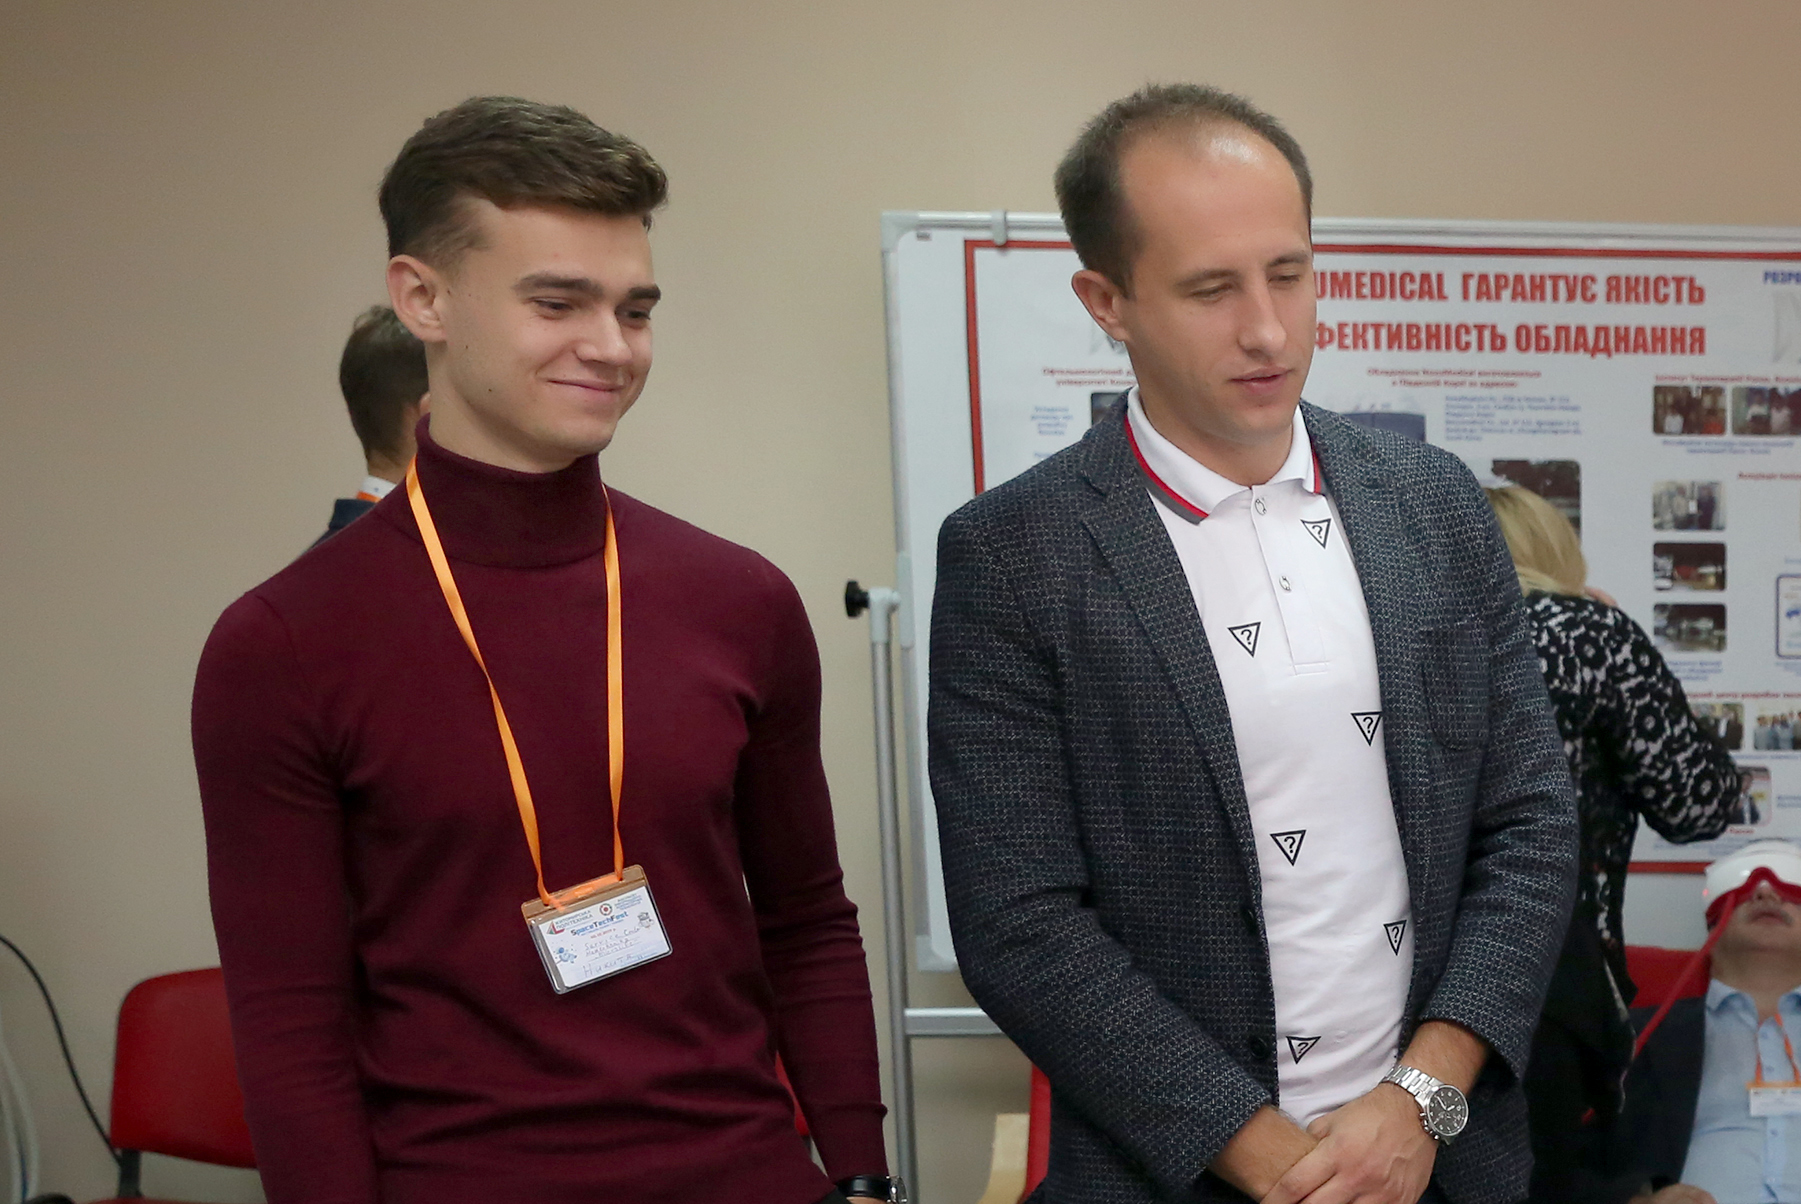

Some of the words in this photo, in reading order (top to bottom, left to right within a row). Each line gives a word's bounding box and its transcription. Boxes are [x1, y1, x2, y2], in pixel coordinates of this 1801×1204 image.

[1314, 271, 1449, 301] UMEDICAL
[1462, 273, 1599, 304] ГАРАНТУЄ
[1605, 275, 1706, 306] ЯКІСТЬ
[1314, 320, 1507, 352] ФЕКТИВНІСТЬ
[1515, 323, 1707, 358] ОБЛАДНАННЯ
